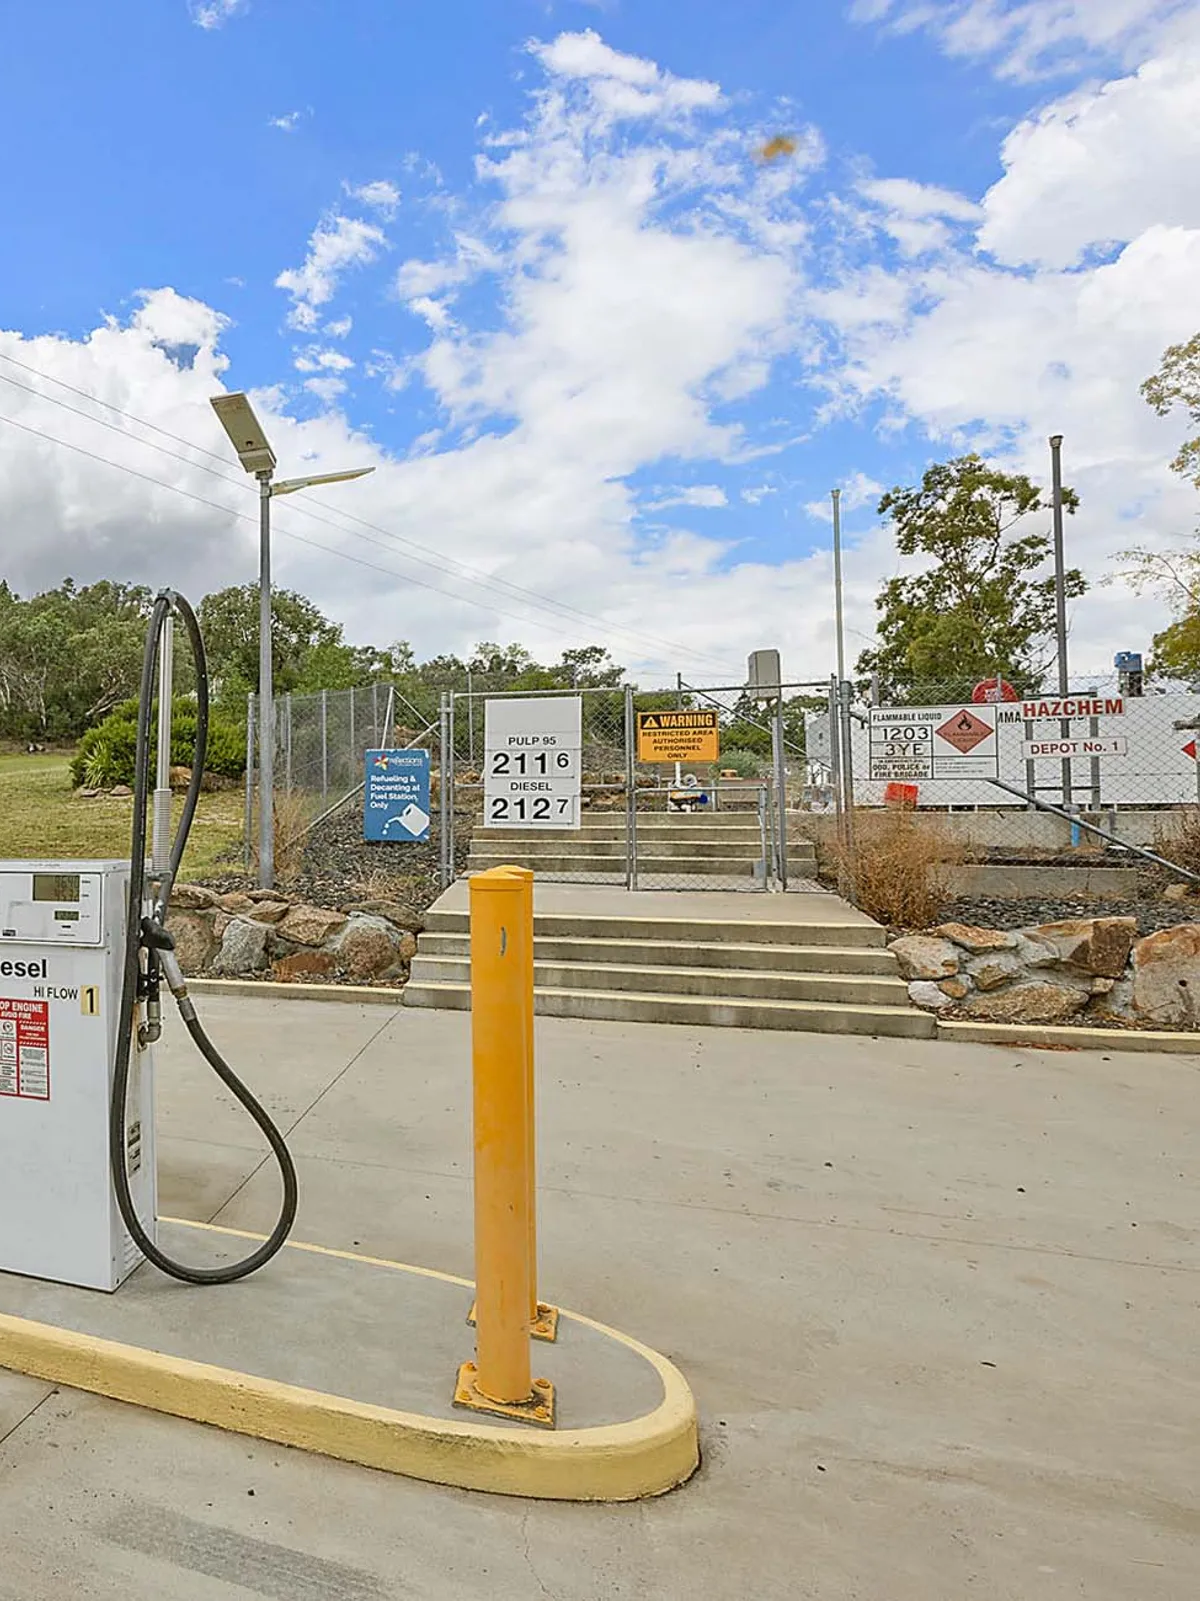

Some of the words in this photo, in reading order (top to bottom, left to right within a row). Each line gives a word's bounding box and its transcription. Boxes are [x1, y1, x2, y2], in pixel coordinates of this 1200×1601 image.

[1023, 698, 1123, 718] HAZCHEM
[660, 714, 713, 728] WARNING
[873, 714, 916, 722] FLAMMABLE
[918, 712, 942, 721] LIQUID
[883, 727, 929, 740] 1203
[508, 736, 540, 746] PULP
[542, 736, 557, 746] 95
[1030, 742, 1078, 755] DEPOT
[1083, 742, 1107, 753] No.
[1112, 741, 1118, 751] 1
[370, 775, 409, 784] Refueling
[370, 783, 410, 793] Decanting
[510, 781, 553, 792] DIESEL
[370, 801, 388, 810] Only
[34, 986, 44, 997] HI
[47, 987, 78, 1000] FLOW
[86, 987, 94, 1013] 1
[12, 1002, 44, 1013] ENGINE
